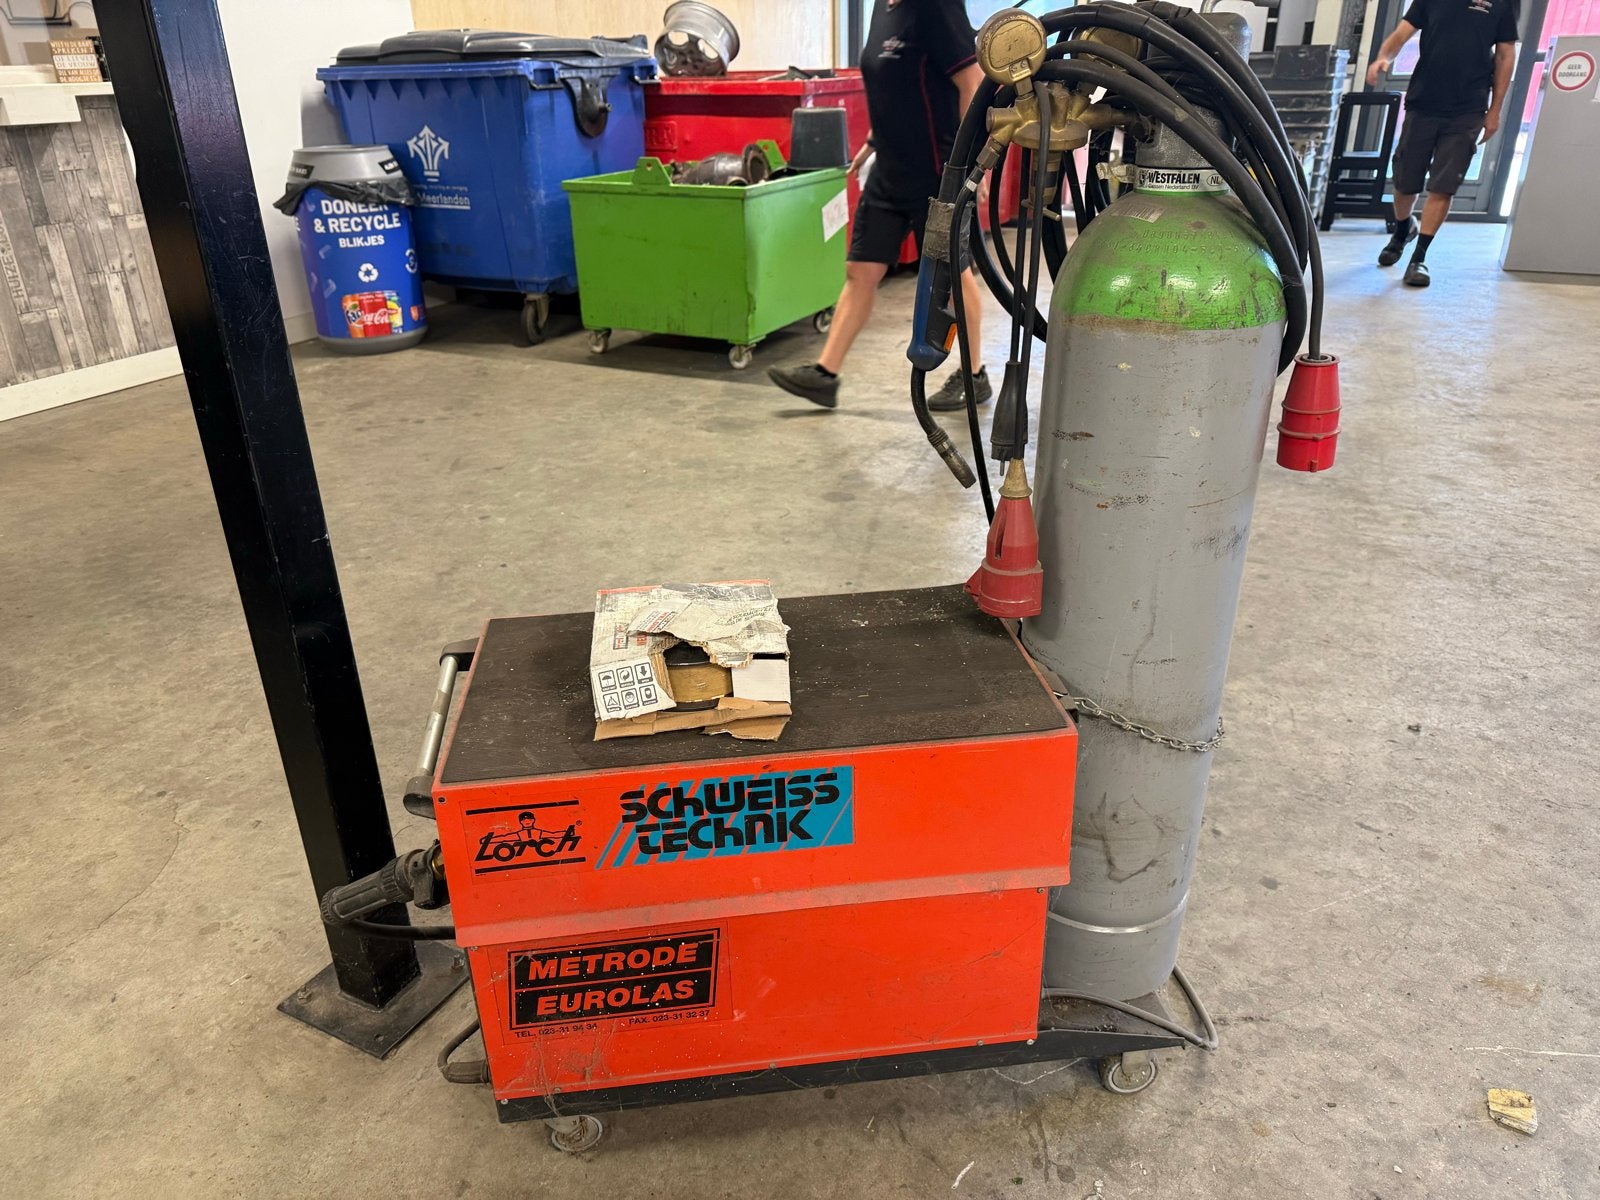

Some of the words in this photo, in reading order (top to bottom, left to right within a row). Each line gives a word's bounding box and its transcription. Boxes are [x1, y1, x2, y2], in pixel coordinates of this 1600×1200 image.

[1148, 170, 1200, 184] WESTFALEN
[313, 218, 326, 233] &
[327, 212, 401, 233] RECYCLE
[338, 234, 385, 248] BLIKJES
[619, 772, 841, 824] SCHWEISS
[634, 808, 814, 856] TECHNIK
[527, 942, 699, 981] METRODE
[536, 979, 696, 1017] EUROLAS
[628, 1017, 650, 1026] FAX.
[652, 1013, 683, 1023] 023-31
[685, 1011, 698, 1020] 32
[699, 1009, 710, 1018] 37
[515, 1030, 537, 1039] TEL.
